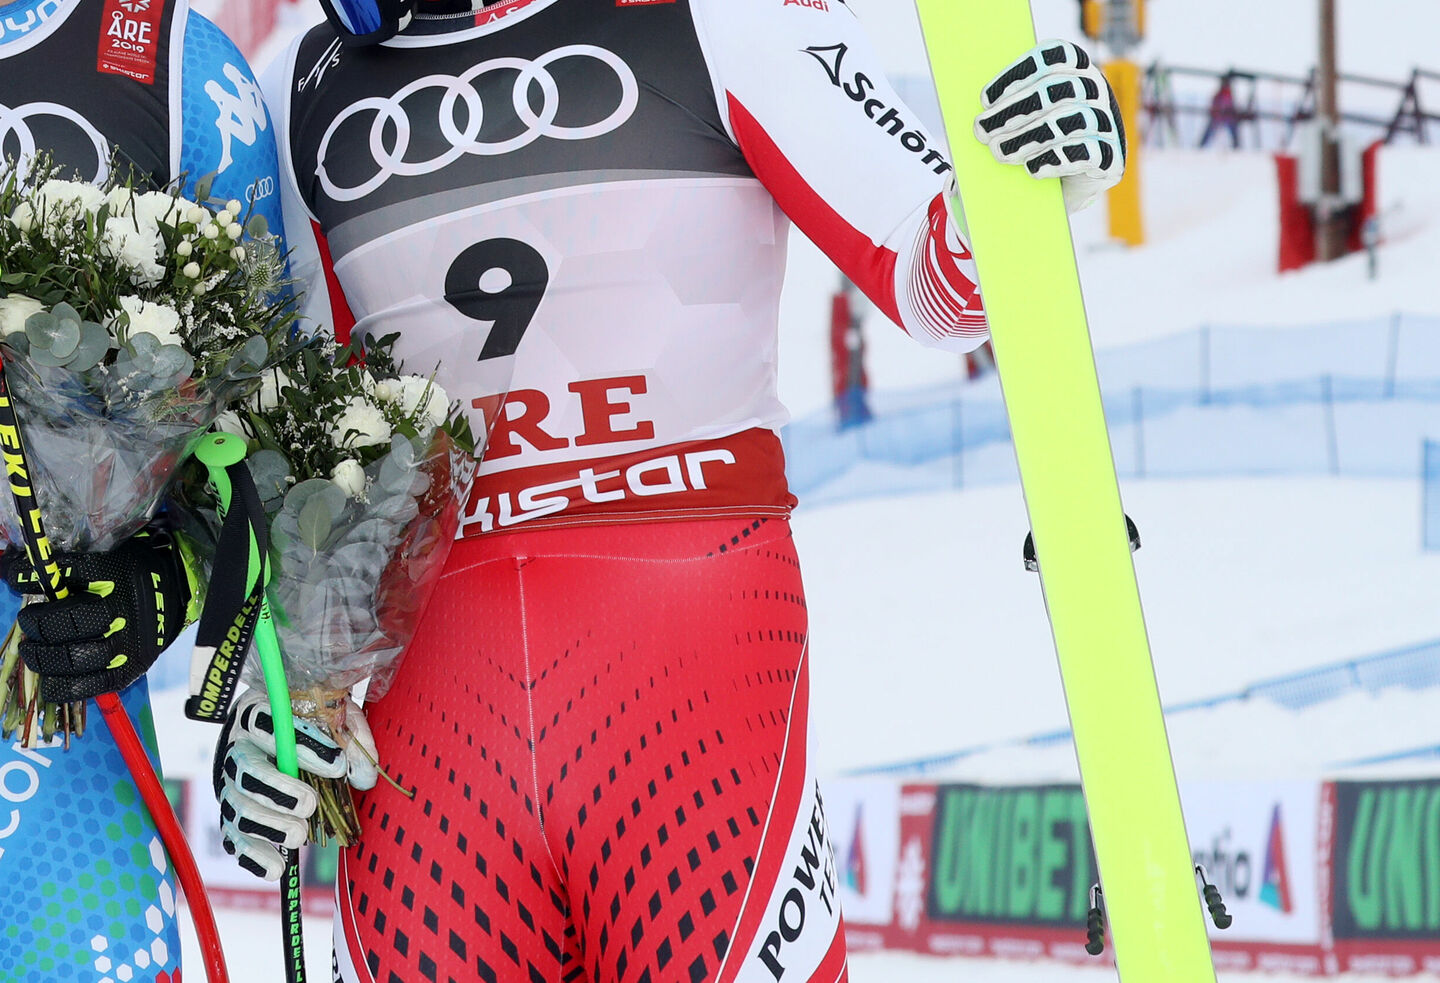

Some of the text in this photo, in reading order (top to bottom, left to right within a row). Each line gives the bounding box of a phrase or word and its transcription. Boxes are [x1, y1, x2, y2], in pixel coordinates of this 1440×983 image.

[107, 10, 152, 44] ÅRE
[111, 38, 145, 53] 2019
[444, 237, 549, 362] 9
[471, 375, 655, 456] RE
[453, 448, 737, 541] kistar
[29, 508, 69, 600] LEKI
[196, 594, 258, 718] KOMPERDELL
[287, 864, 303, 983] KOMPERDELL
